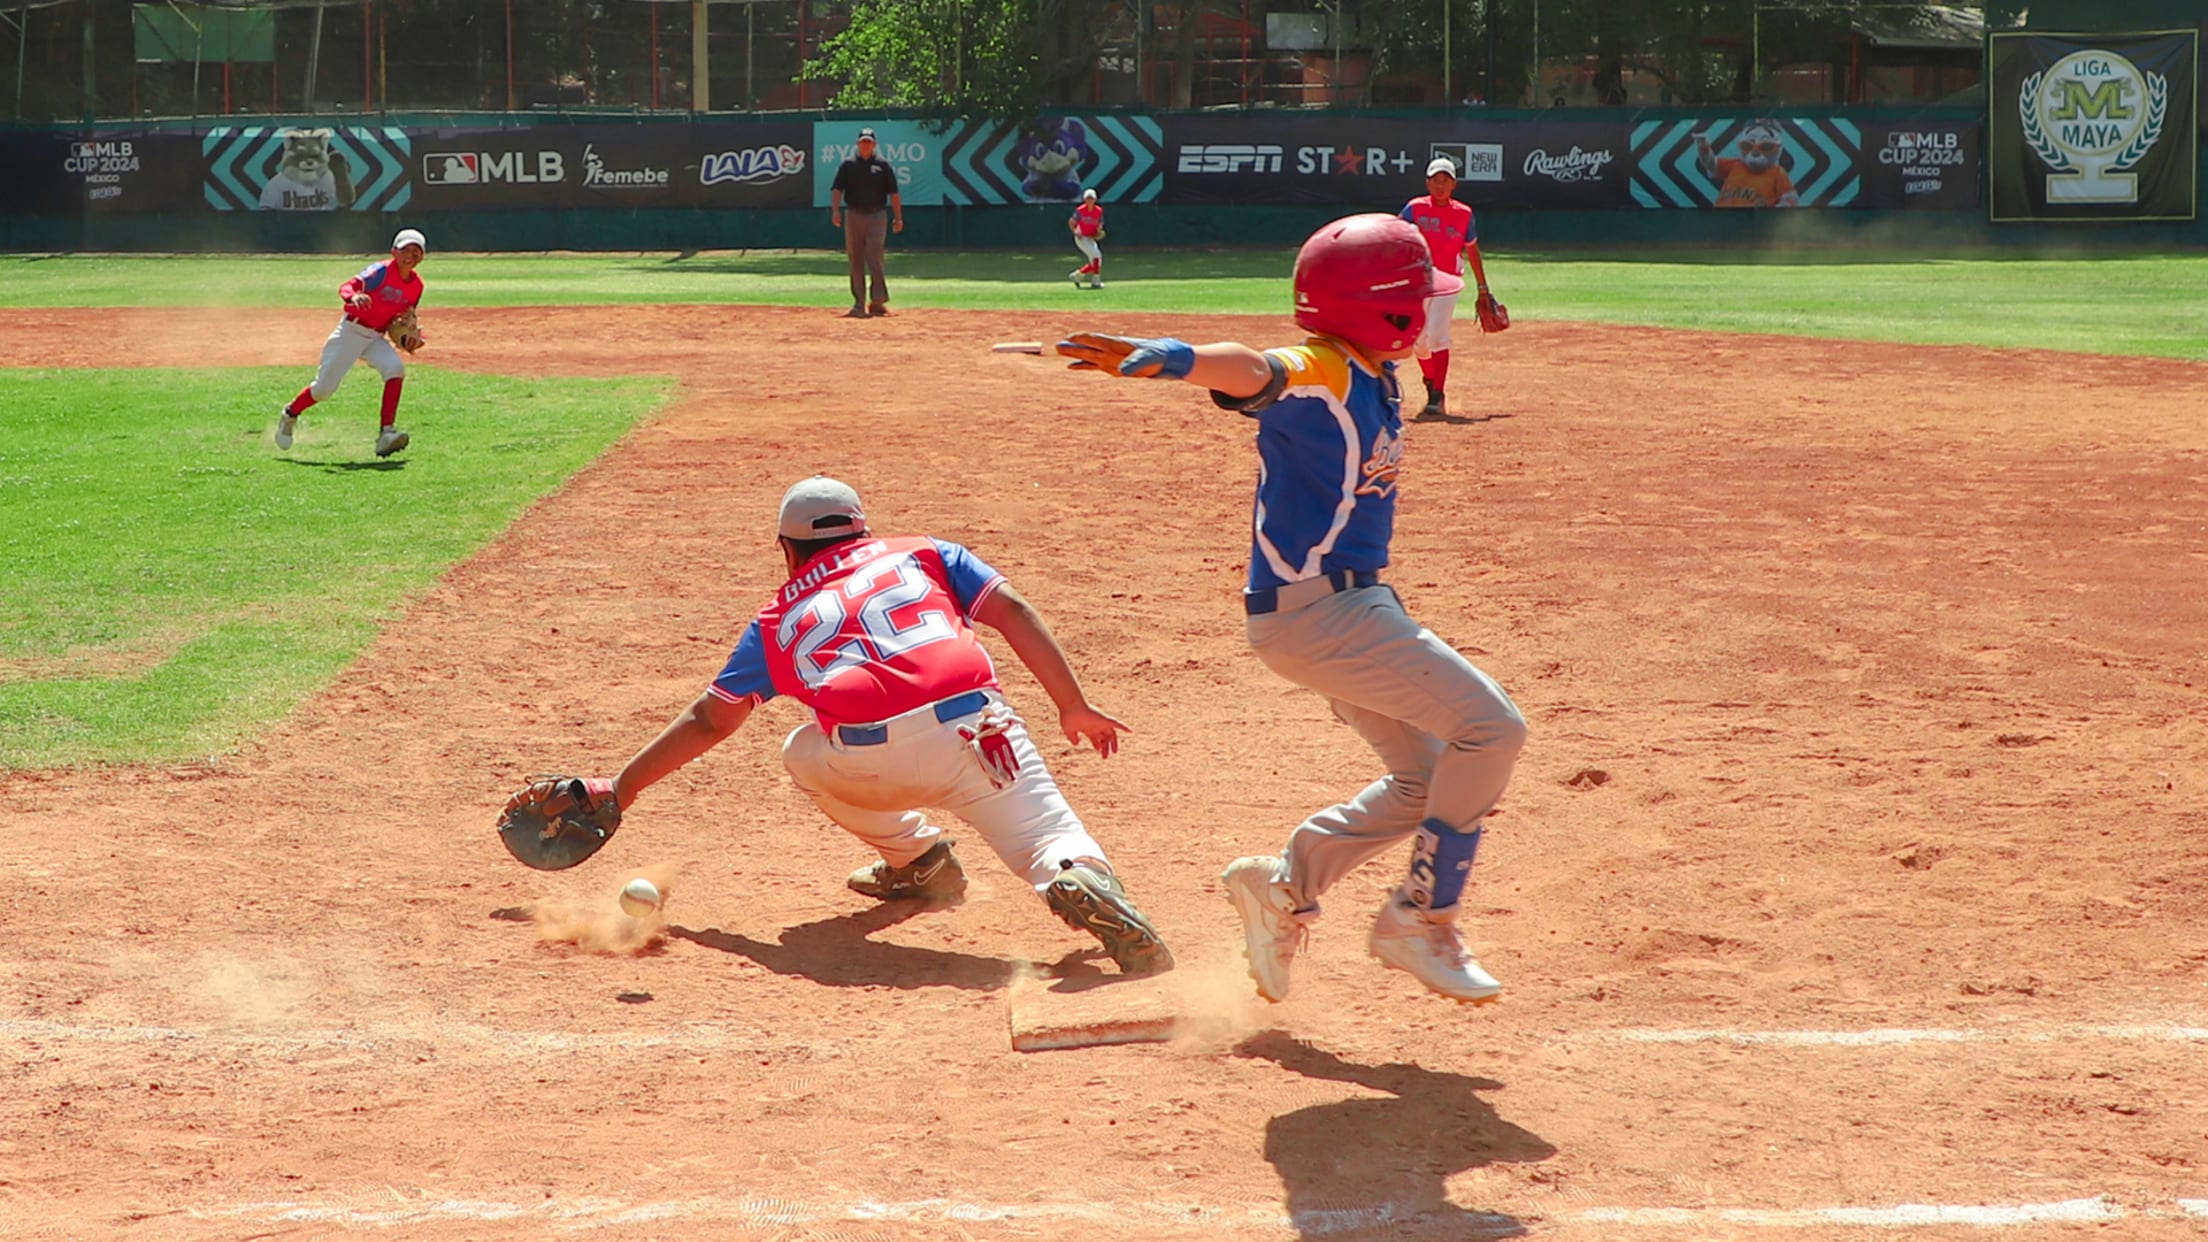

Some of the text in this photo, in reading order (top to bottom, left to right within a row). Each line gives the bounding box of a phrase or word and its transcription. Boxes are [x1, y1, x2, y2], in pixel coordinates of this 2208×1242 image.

[2074, 60, 2112, 77] LIGA
[2048, 76, 2135, 121] M
[1916, 132, 1957, 148] MLB
[2062, 124, 2122, 149] MAYA
[95, 142, 133, 157] MLB
[1471, 152, 1497, 162] NEW
[1878, 148, 1964, 165] CUP 2024
[64, 156, 140, 172] CUP 2024
[480, 151, 564, 184] MLB
[700, 146, 782, 185] LALA
[1178, 145, 1283, 173] ESPN
[1471, 161, 1497, 173] ERA
[1523, 145, 1614, 176] Rawlings
[594, 167, 669, 184] Femebe
[777, 552, 957, 690] 22
